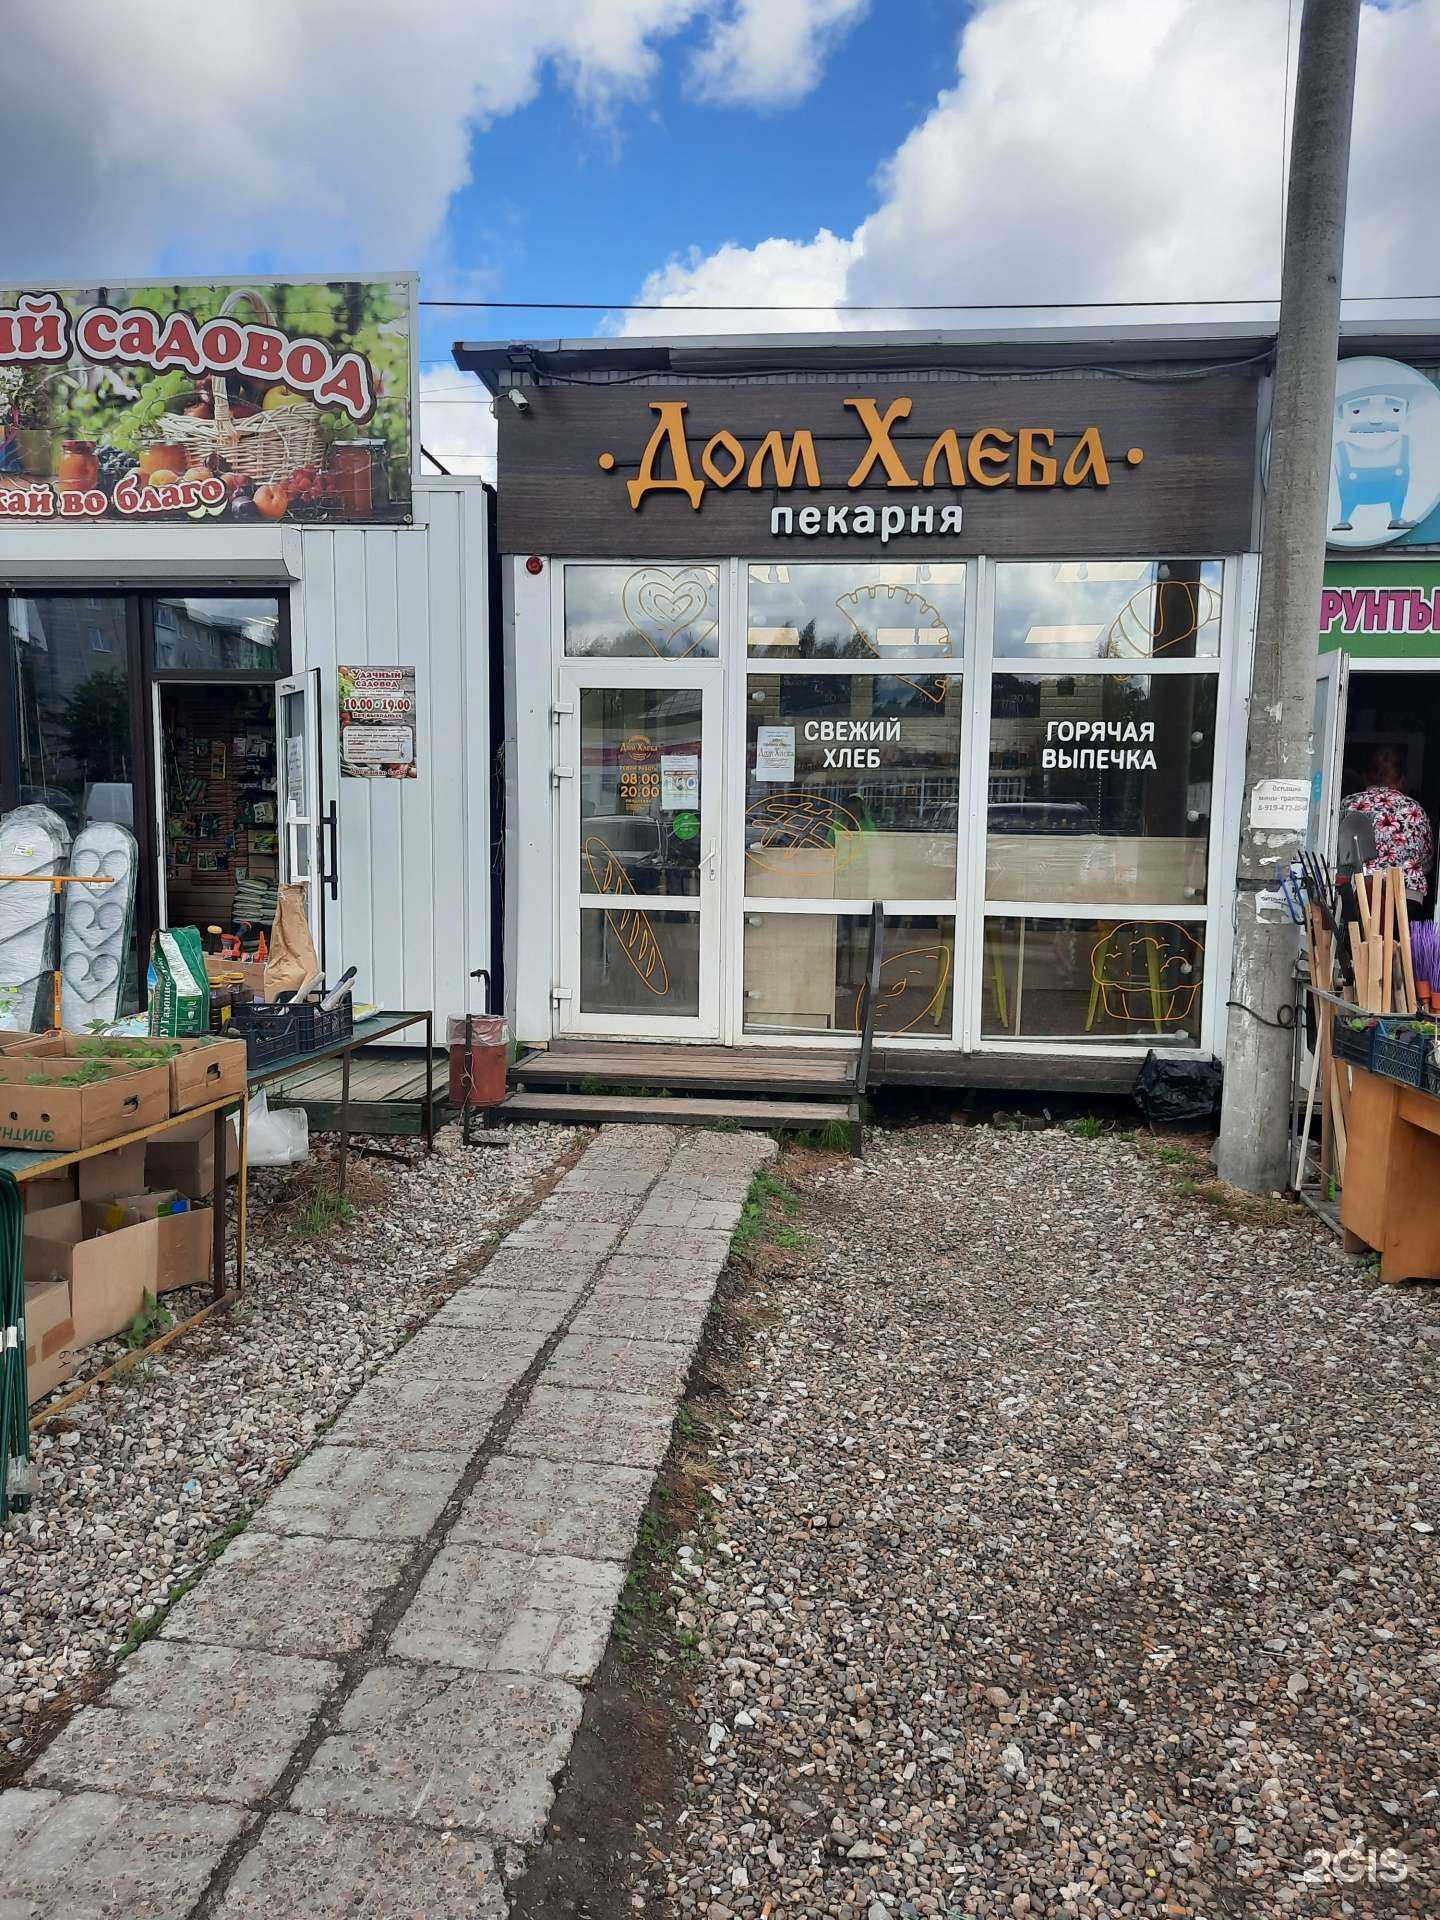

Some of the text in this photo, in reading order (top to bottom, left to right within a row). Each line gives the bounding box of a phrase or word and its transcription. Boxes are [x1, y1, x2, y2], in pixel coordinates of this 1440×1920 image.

[81, 311, 368, 414] садовод
[61, 489, 107, 514] во
[115, 476, 223, 512] благо
[770, 504, 963, 543] пекарня
[345, 699, 373, 710] 10.00
[382, 699, 410, 711] 19.00
[804, 716, 901, 742] СВЕЖИЙ
[1046, 721, 1155, 742] ГОРЯЧАЯ
[822, 748, 881, 768] ХЛЕБ
[1041, 748, 1157, 770] ВЫПЕЧКА
[621, 773, 659, 785] 08:00
[620, 785, 659, 798] 20:00
